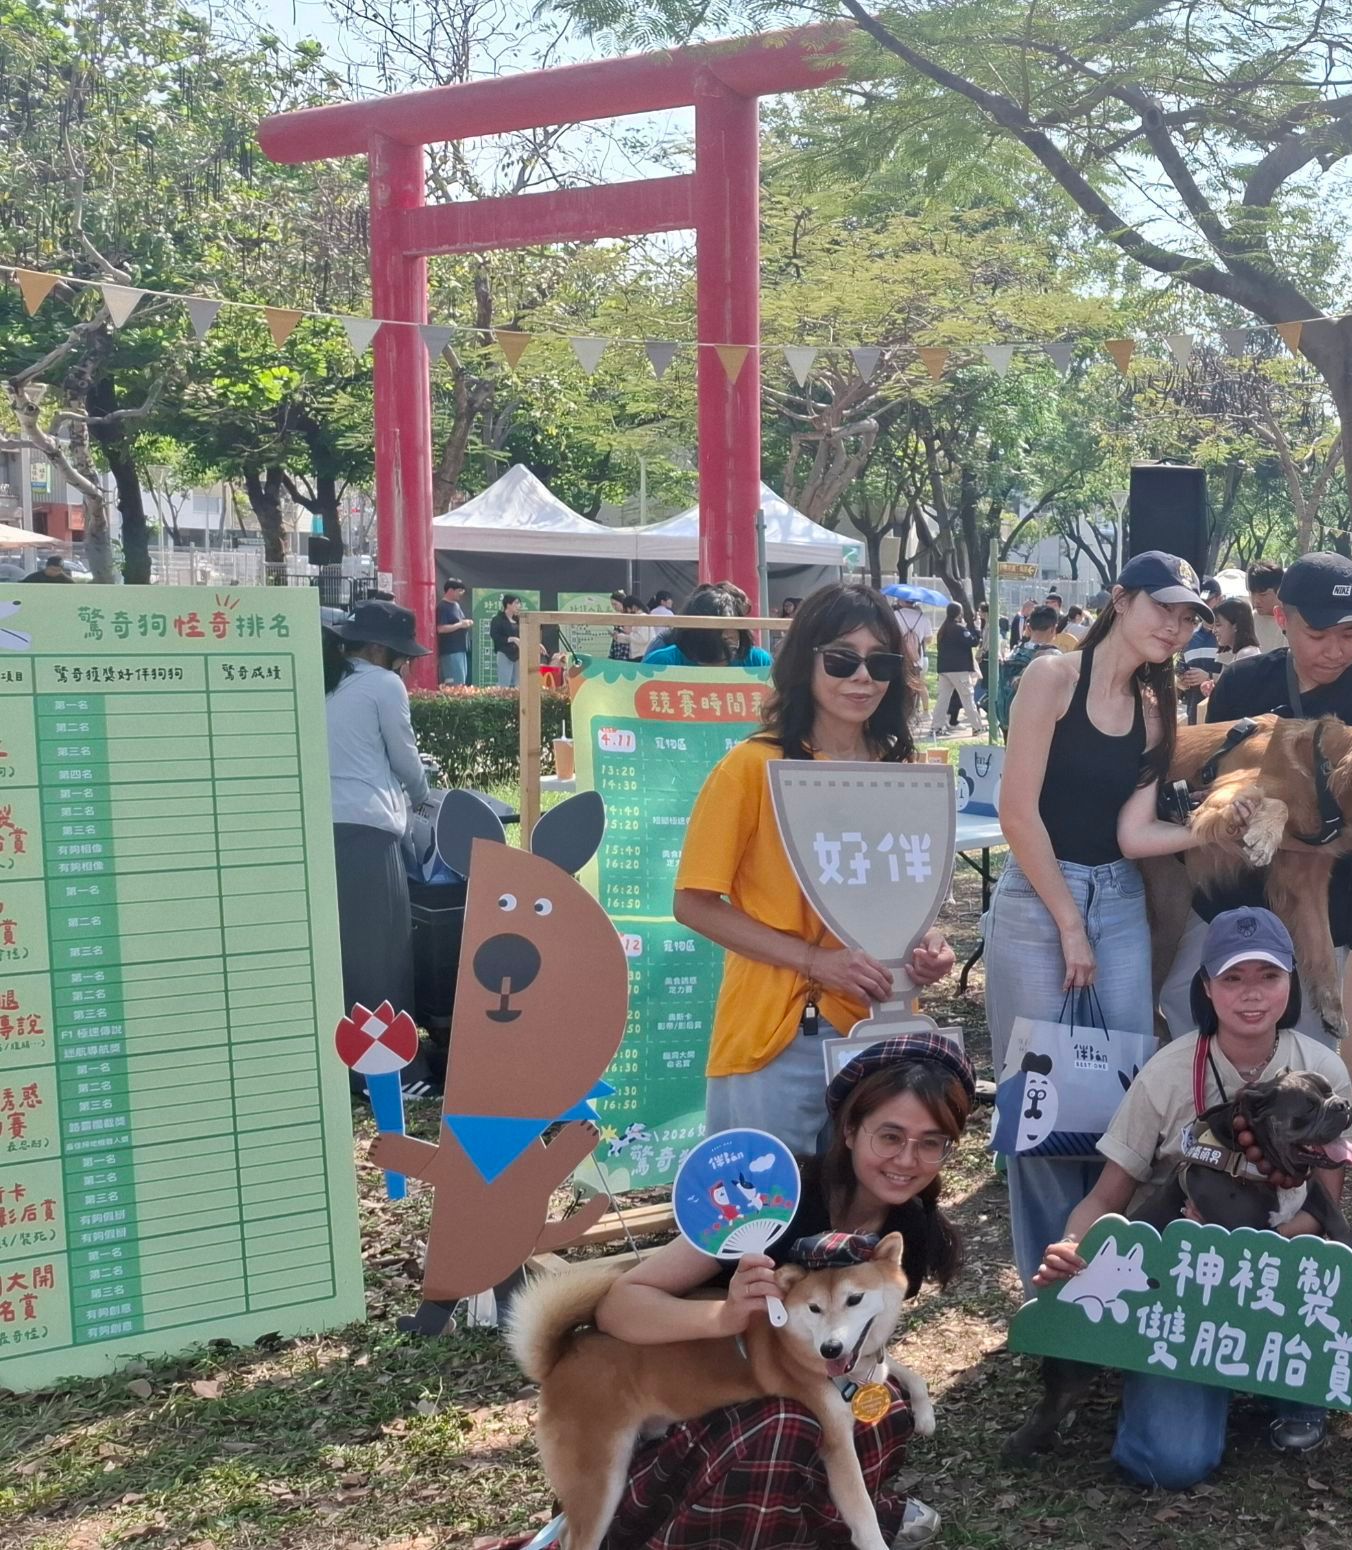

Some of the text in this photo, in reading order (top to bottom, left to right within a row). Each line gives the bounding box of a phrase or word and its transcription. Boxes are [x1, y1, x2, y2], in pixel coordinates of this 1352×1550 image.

[1333, 585, 1352, 596] NIKE
[77, 606, 290, 641] 驚奇狗怪奇排名
[221, 663, 281, 681] 驚奇成績
[54, 700, 88, 711] 第一名
[55, 722, 90, 733] 第二名
[57, 746, 91, 757] 第三名
[58, 769, 93, 780] 第四名
[601, 765, 636, 776] 13:20
[602, 779, 637, 790] 14:30
[60, 788, 94, 799] 第一名
[61, 807, 95, 817] 第二名
[62, 825, 96, 835] 第三名
[605, 845, 641, 856] 15:40
[605, 858, 639, 869] 16:20
[813, 831, 932, 885] 好伴
[66, 885, 99, 896] 第一名
[607, 884, 640, 895] 16:20
[607, 898, 641, 909] 16:50
[68, 916, 101, 927] 第二名
[69, 945, 103, 957] 第三名
[71, 971, 105, 982] 第一名
[72, 989, 106, 1001] 第二名
[73, 1008, 107, 1019] 第三名
[77, 1063, 110, 1075] 第一名
[78, 1081, 112, 1093] 第二名
[79, 1100, 112, 1111] 第三名
[603, 1099, 637, 1110] 16:50
[83, 1155, 116, 1168] 第一名
[630, 1144, 690, 1177] 驚奇
[84, 1172, 118, 1185] 第二名
[85, 1191, 119, 1205] 第三名
[88, 1248, 122, 1261] 第一名
[89, 1266, 124, 1280] 第二名
[0, 1264, 54, 1296] 大開
[91, 1285, 124, 1298] 第三名
[1169, 1240, 1341, 1332] 神複製
